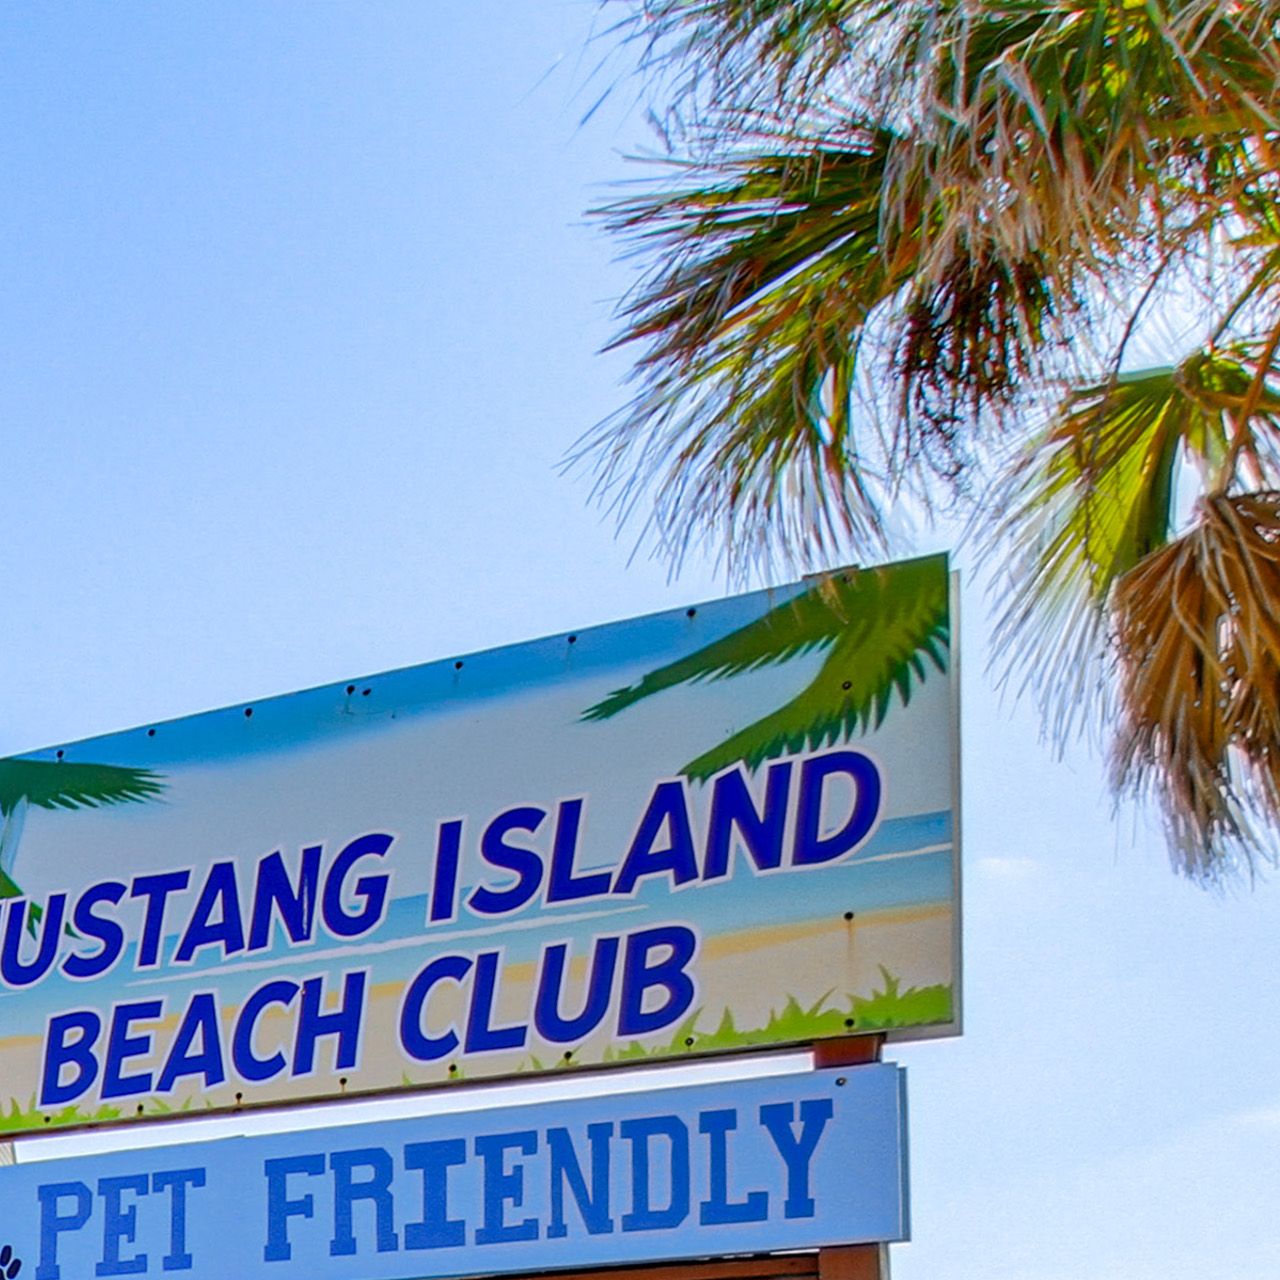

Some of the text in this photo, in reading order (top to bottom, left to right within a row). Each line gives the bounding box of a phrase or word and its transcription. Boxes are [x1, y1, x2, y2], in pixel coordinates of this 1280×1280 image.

[429, 750, 881, 922] ISLAND
[39, 925, 697, 1106] BEACH CLUB
[263, 1097, 836, 1264] FRIENDLY
